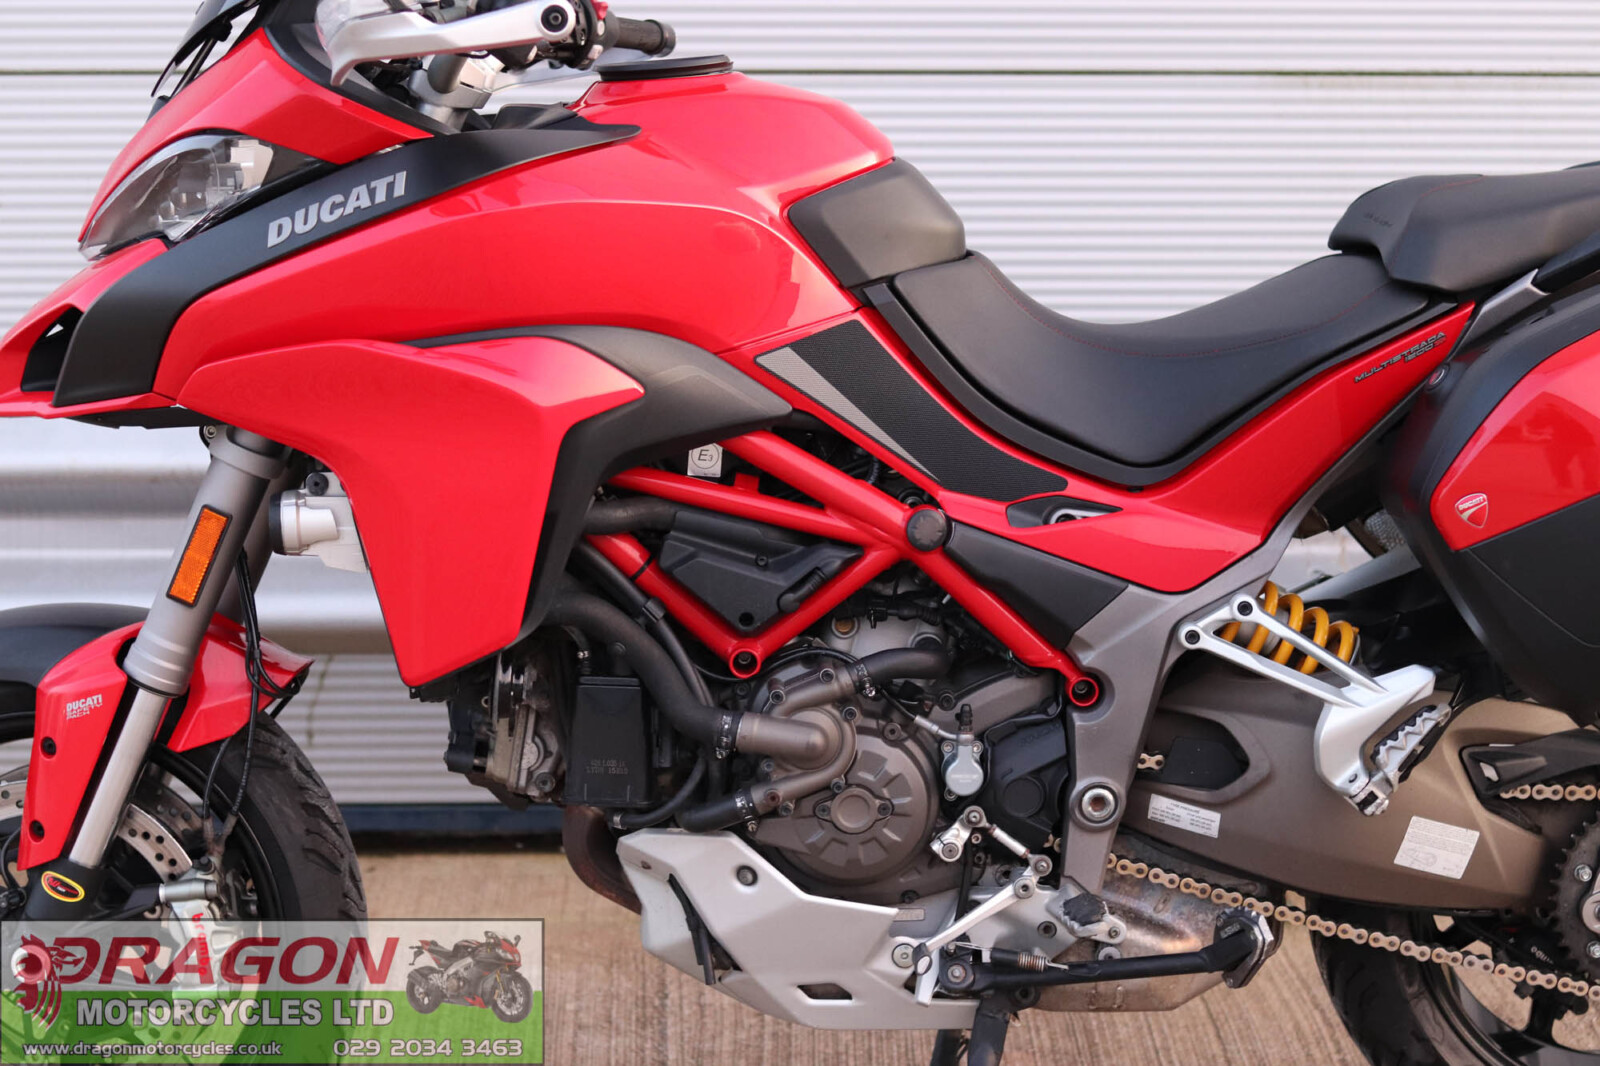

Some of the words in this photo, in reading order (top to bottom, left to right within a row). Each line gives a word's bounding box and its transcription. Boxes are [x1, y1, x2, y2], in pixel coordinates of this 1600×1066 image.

[267, 170, 407, 249] DUCATI
[1354, 332, 1446, 383] MULTISTRADA
[66, 694, 102, 711] DUCATI
